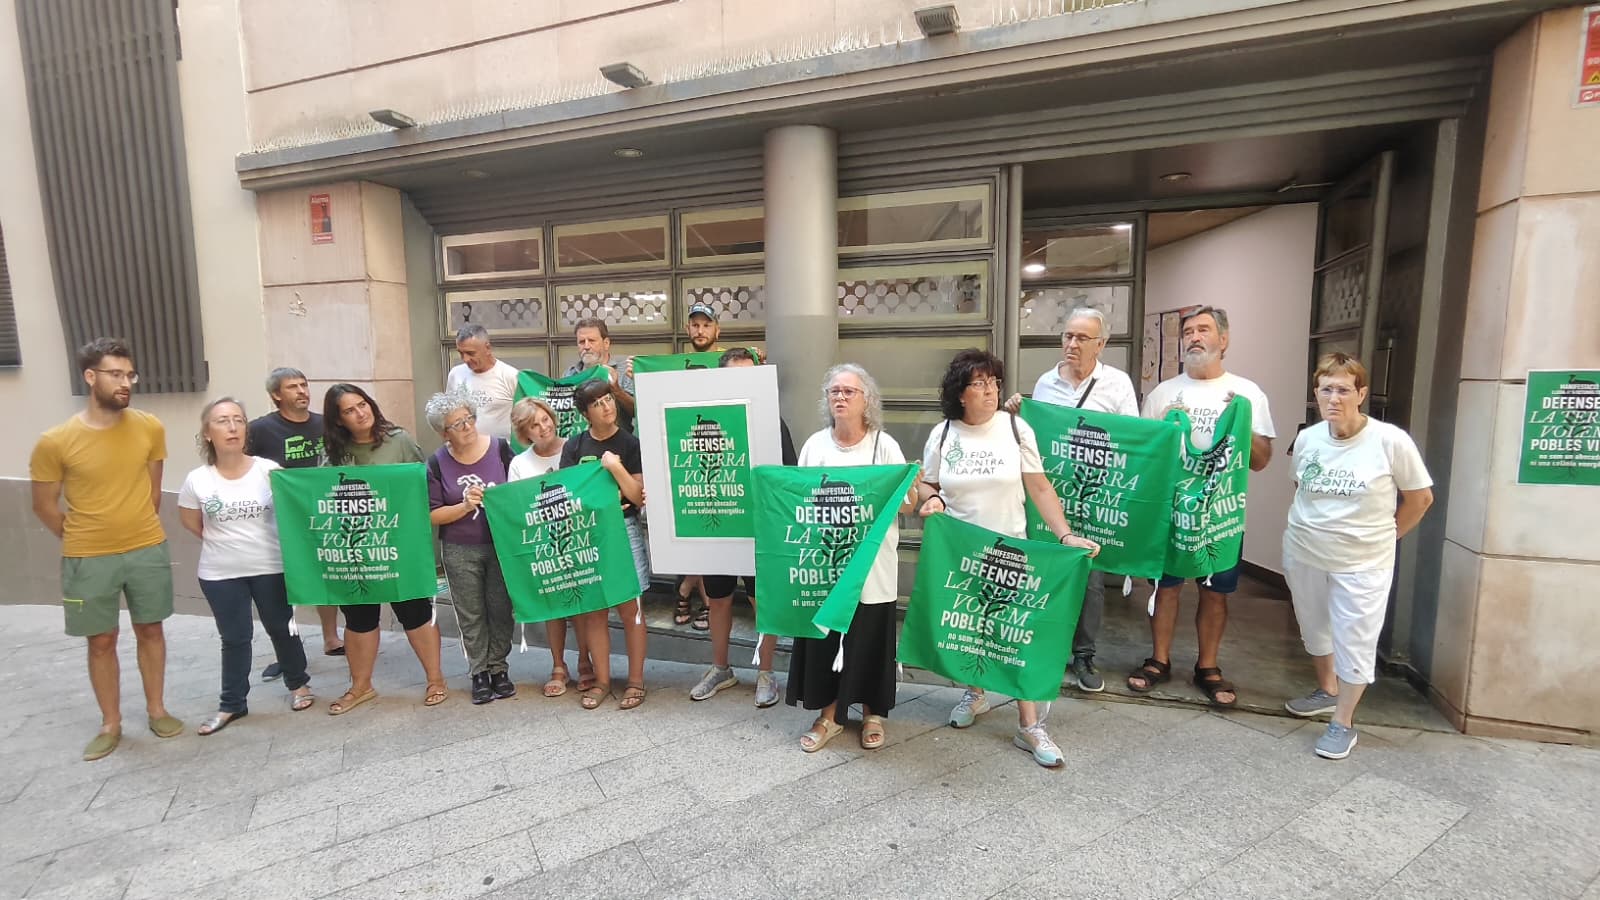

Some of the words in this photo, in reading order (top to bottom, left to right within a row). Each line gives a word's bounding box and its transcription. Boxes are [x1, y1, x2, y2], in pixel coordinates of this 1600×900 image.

[1542, 396, 1600, 409] DEFENSE
[1528, 410, 1556, 423] LA
[1561, 410, 1600, 423] TER
[680, 437, 734, 452] DEFENSEM
[1530, 439, 1582, 451] POBLES
[673, 454, 692, 467] LA
[696, 452, 746, 467] TERRA
[958, 458, 1004, 468] CONTRA
[1052, 440, 1127, 469] DEFENSEM
[684, 469, 736, 484] VOLEM
[1071, 464, 1140, 491] TERRA
[1313, 477, 1366, 489] CONTRA
[678, 484, 717, 498] POBLES
[720, 484, 744, 497] VIUS
[812, 486, 855, 495] MANIFESTACIÓ
[219, 505, 270, 516] CONTRA
[318, 498, 387, 514] DEFENSEM
[525, 498, 582, 526] DEFENSEM
[1214, 492, 1246, 517] VIUS
[309, 516, 333, 530] LA
[337, 513, 399, 530] TERRA
[796, 504, 874, 524] DEFENSEM
[1096, 505, 1129, 527] VIUS
[520, 529, 542, 544] LA
[545, 511, 597, 537] TERRA
[784, 525, 811, 545] LA
[1083, 523, 1116, 536] abocador
[323, 531, 389, 548] VOLEM
[535, 531, 590, 561] VOLEM
[317, 547, 363, 563] POBLES
[367, 547, 398, 562] VIUS
[531, 553, 574, 577] POBLES
[576, 547, 599, 566] VIUS
[799, 547, 855, 566] VOLE
[983, 545, 1028, 563] MANIFESTACIÓ
[960, 556, 1042, 592] DEFENSEM
[944, 570, 973, 591] LA
[978, 580, 1050, 610] TERRA
[792, 598, 799, 607] ni
[952, 593, 1032, 627] VOLEM
[941, 610, 995, 635] POBLES
[1000, 625, 1034, 645] VIUS
[947, 632, 957, 640] no
[958, 634, 973, 643] som
[985, 639, 1019, 655] abocador
[937, 640, 945, 648] ni
[946, 642, 959, 650] una
[987, 651, 1026, 667] energètica
